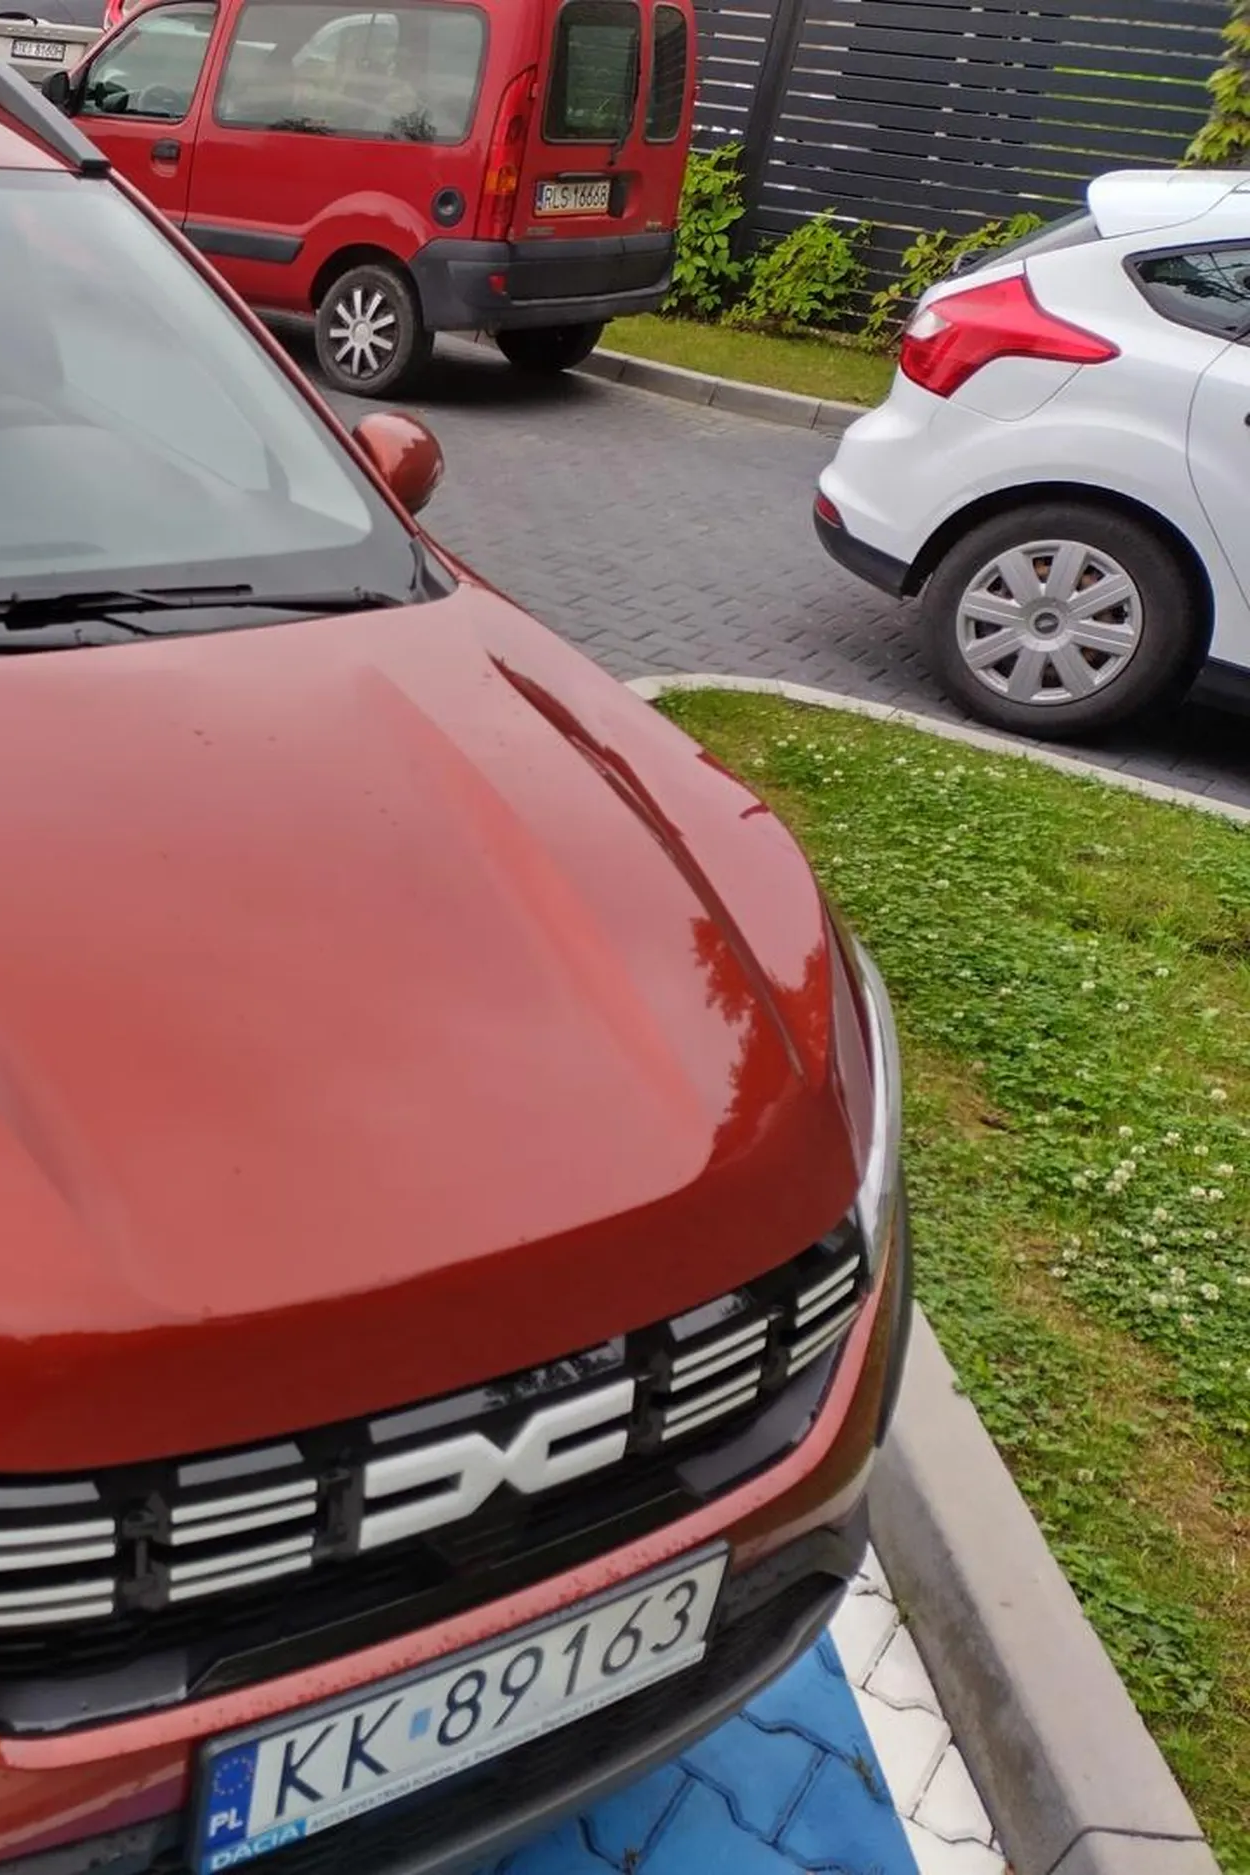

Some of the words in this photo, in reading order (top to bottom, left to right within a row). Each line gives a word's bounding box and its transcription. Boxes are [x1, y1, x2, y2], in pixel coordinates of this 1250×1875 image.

[274, 1698, 404, 1819] KK
[437, 1579, 699, 1748] 89163
[208, 1806, 244, 1839] PL
[210, 1824, 300, 1870] DACIA
